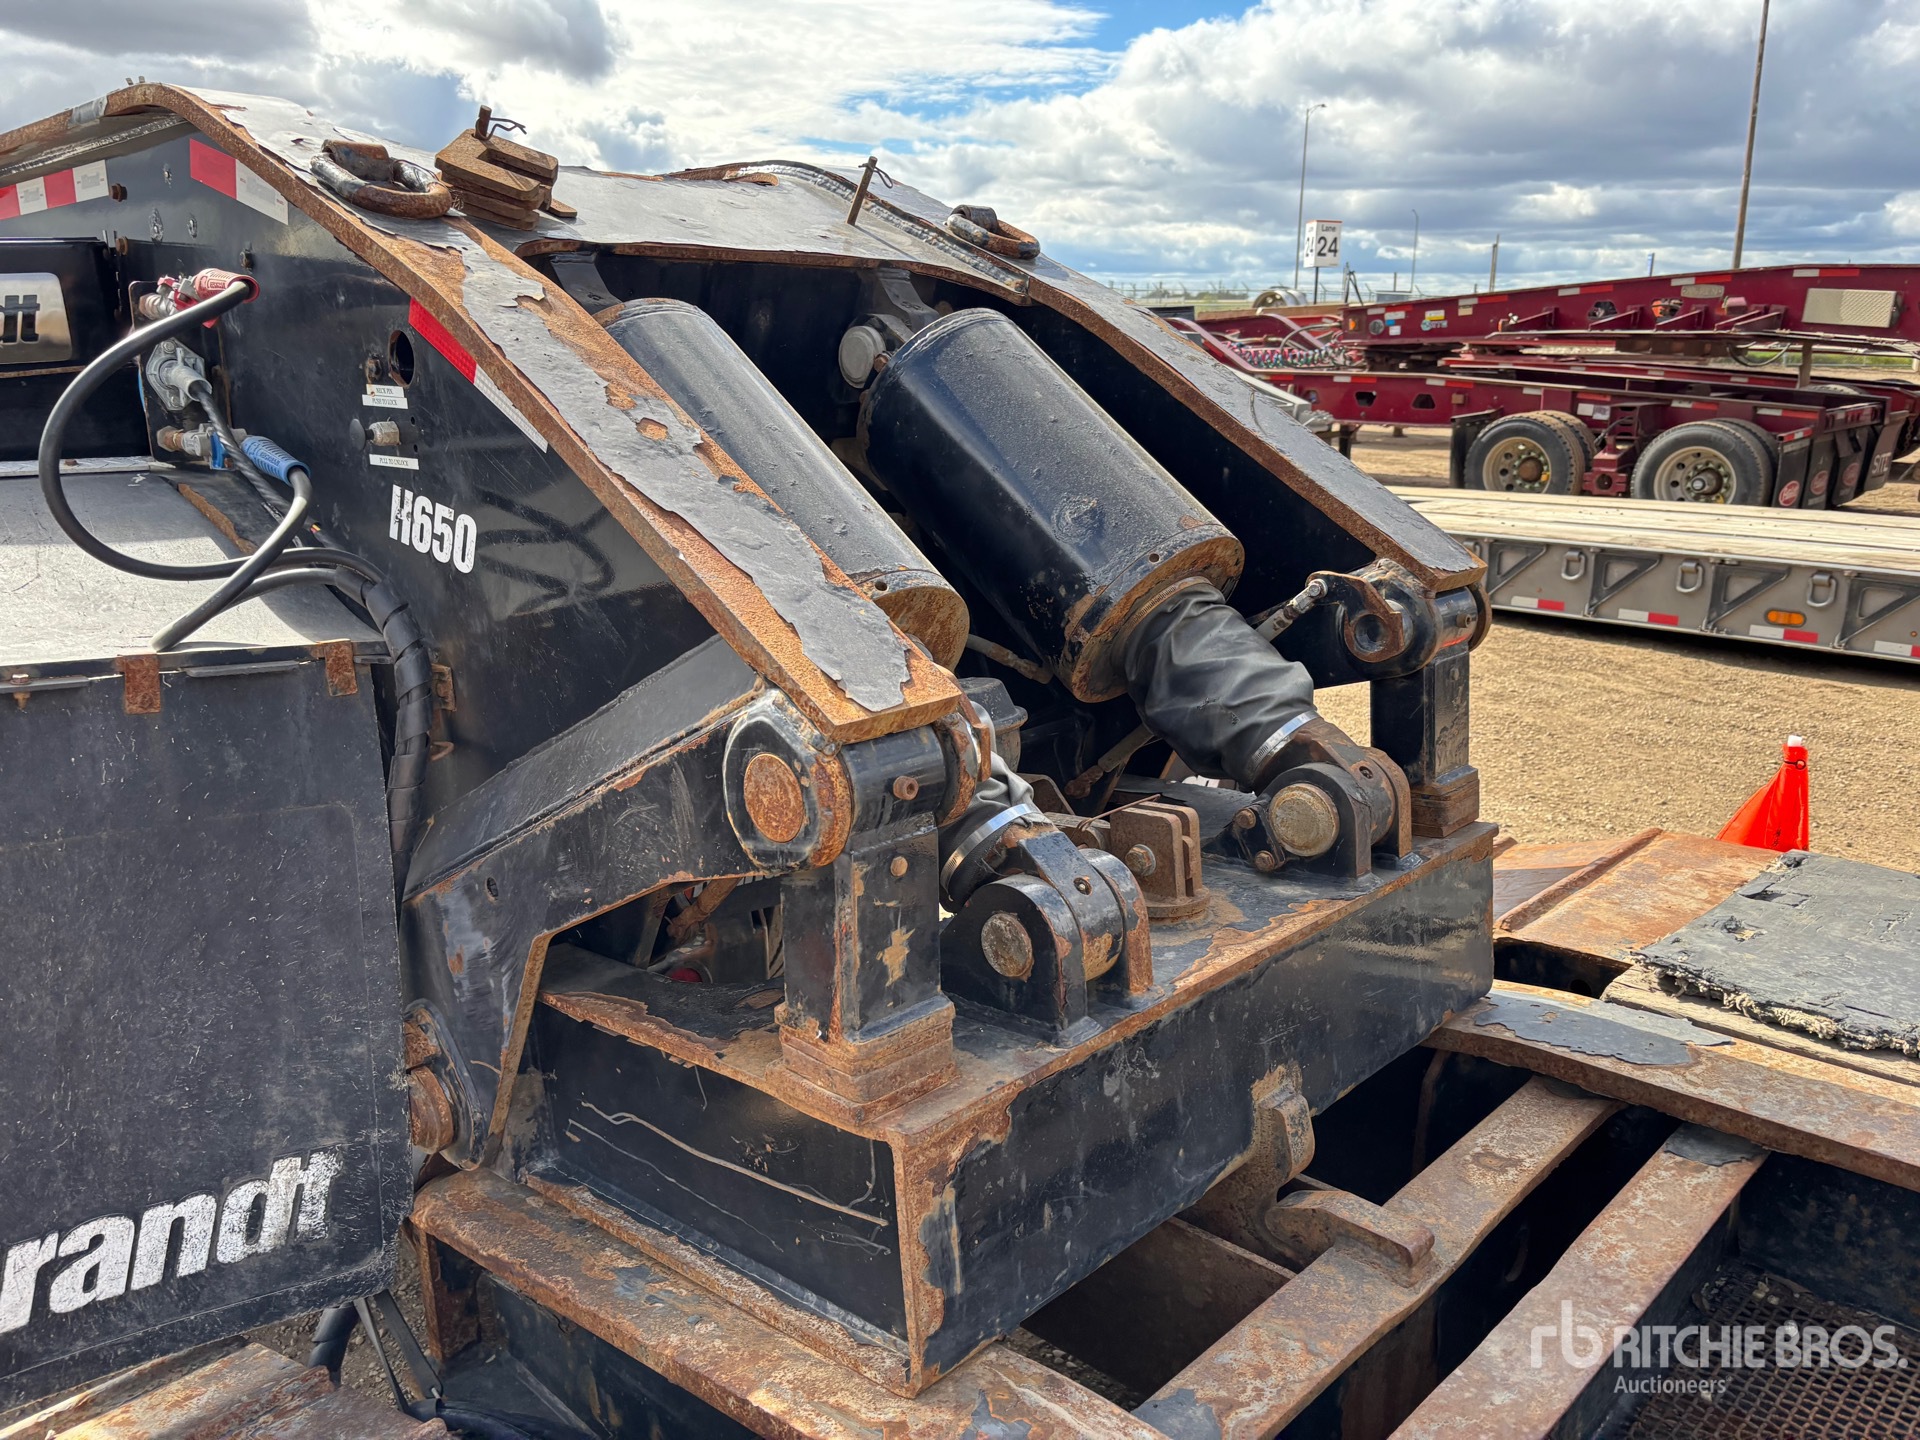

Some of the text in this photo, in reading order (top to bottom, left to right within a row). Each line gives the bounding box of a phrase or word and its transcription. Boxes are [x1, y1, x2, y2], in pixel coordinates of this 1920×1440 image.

[1321, 224, 1336, 232] Lane
[1317, 236, 1338, 257] 24
[389, 484, 477, 574] H650
